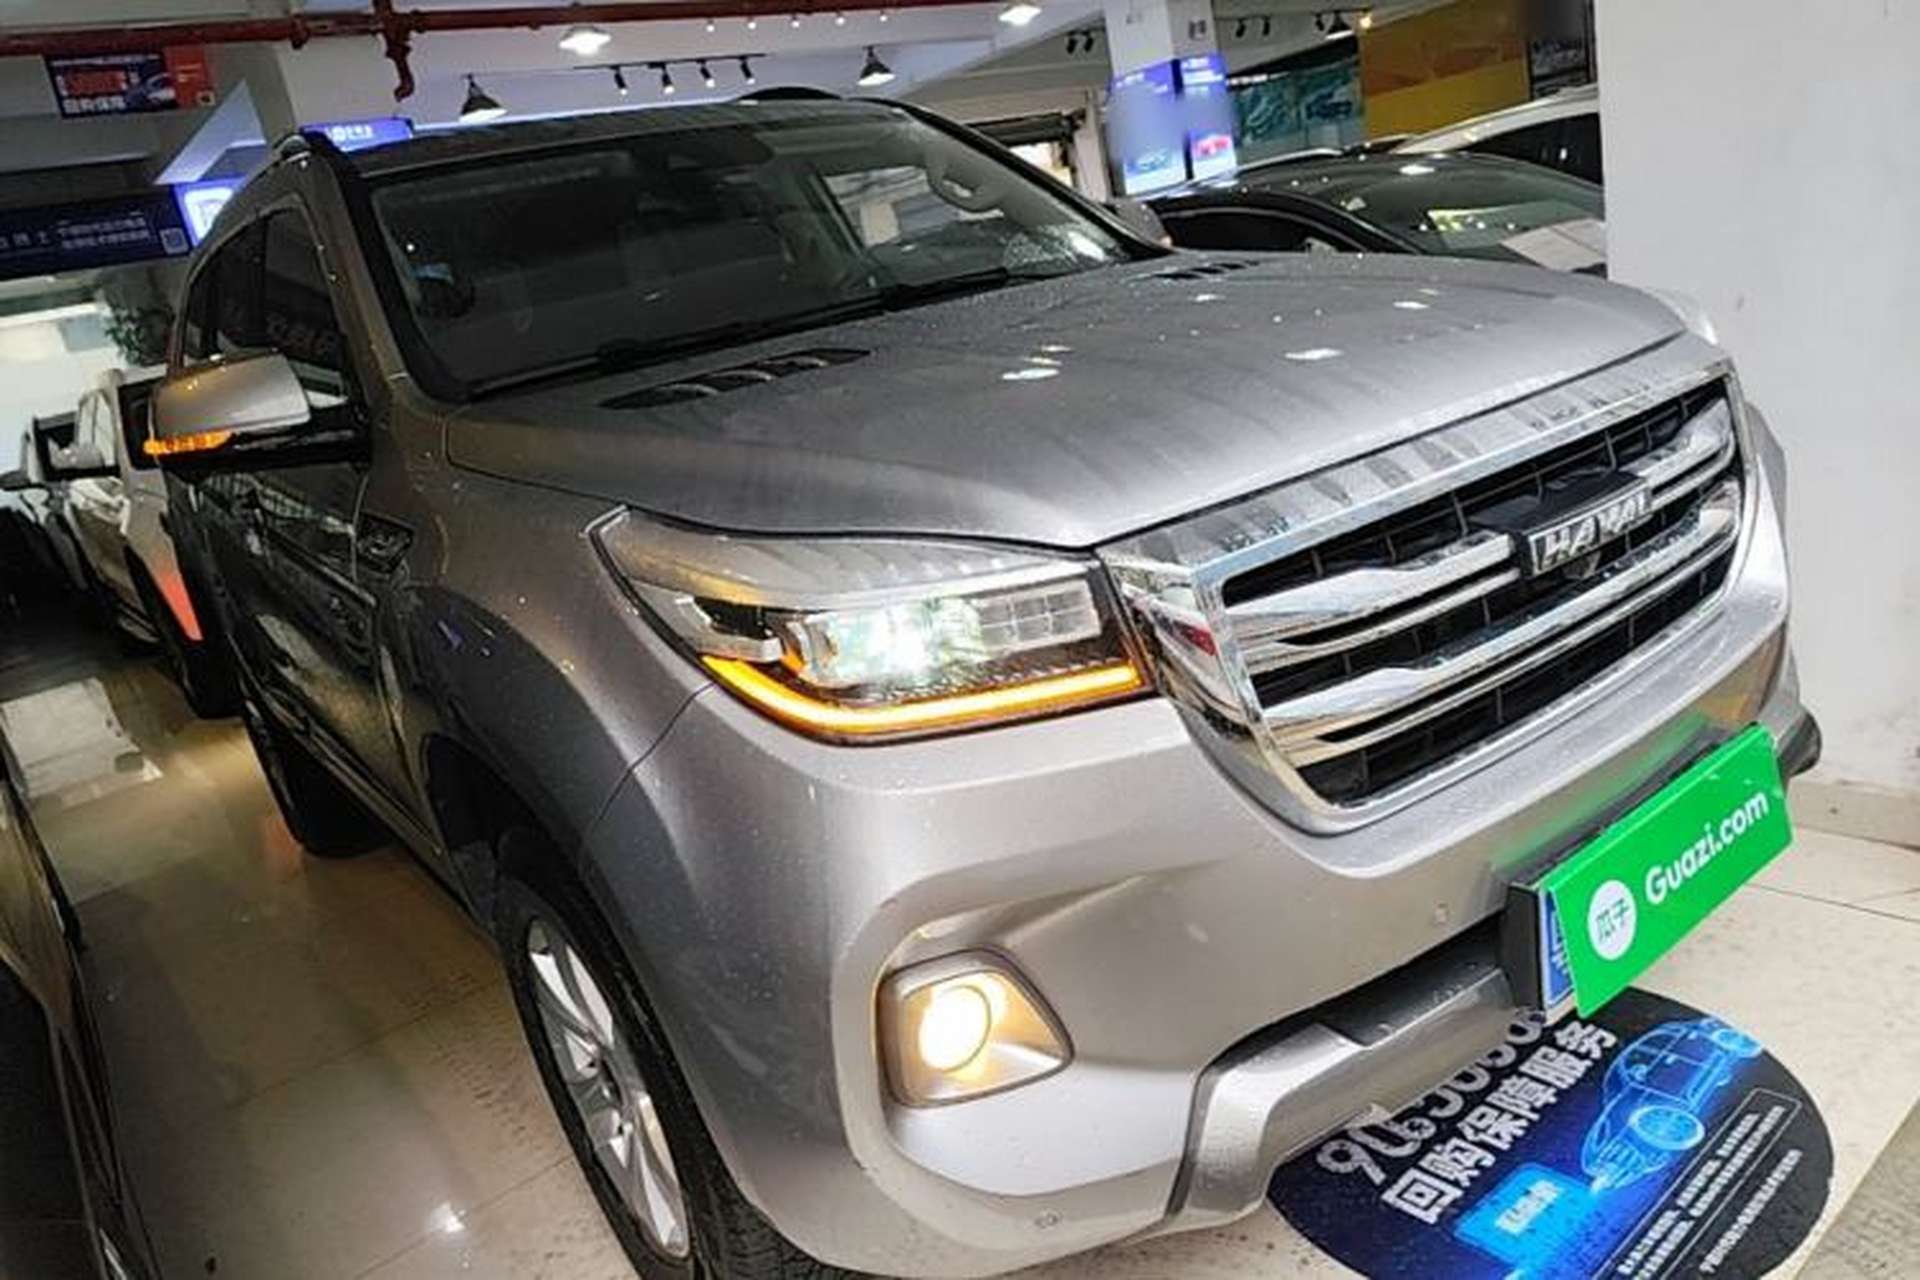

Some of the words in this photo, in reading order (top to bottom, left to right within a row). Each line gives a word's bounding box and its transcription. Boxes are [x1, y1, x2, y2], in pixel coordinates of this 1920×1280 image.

[1543, 490, 1648, 566] HAVAL
[1645, 791, 1770, 905] Guazi.com
[1380, 1020, 1618, 1225] 回购保障服务
